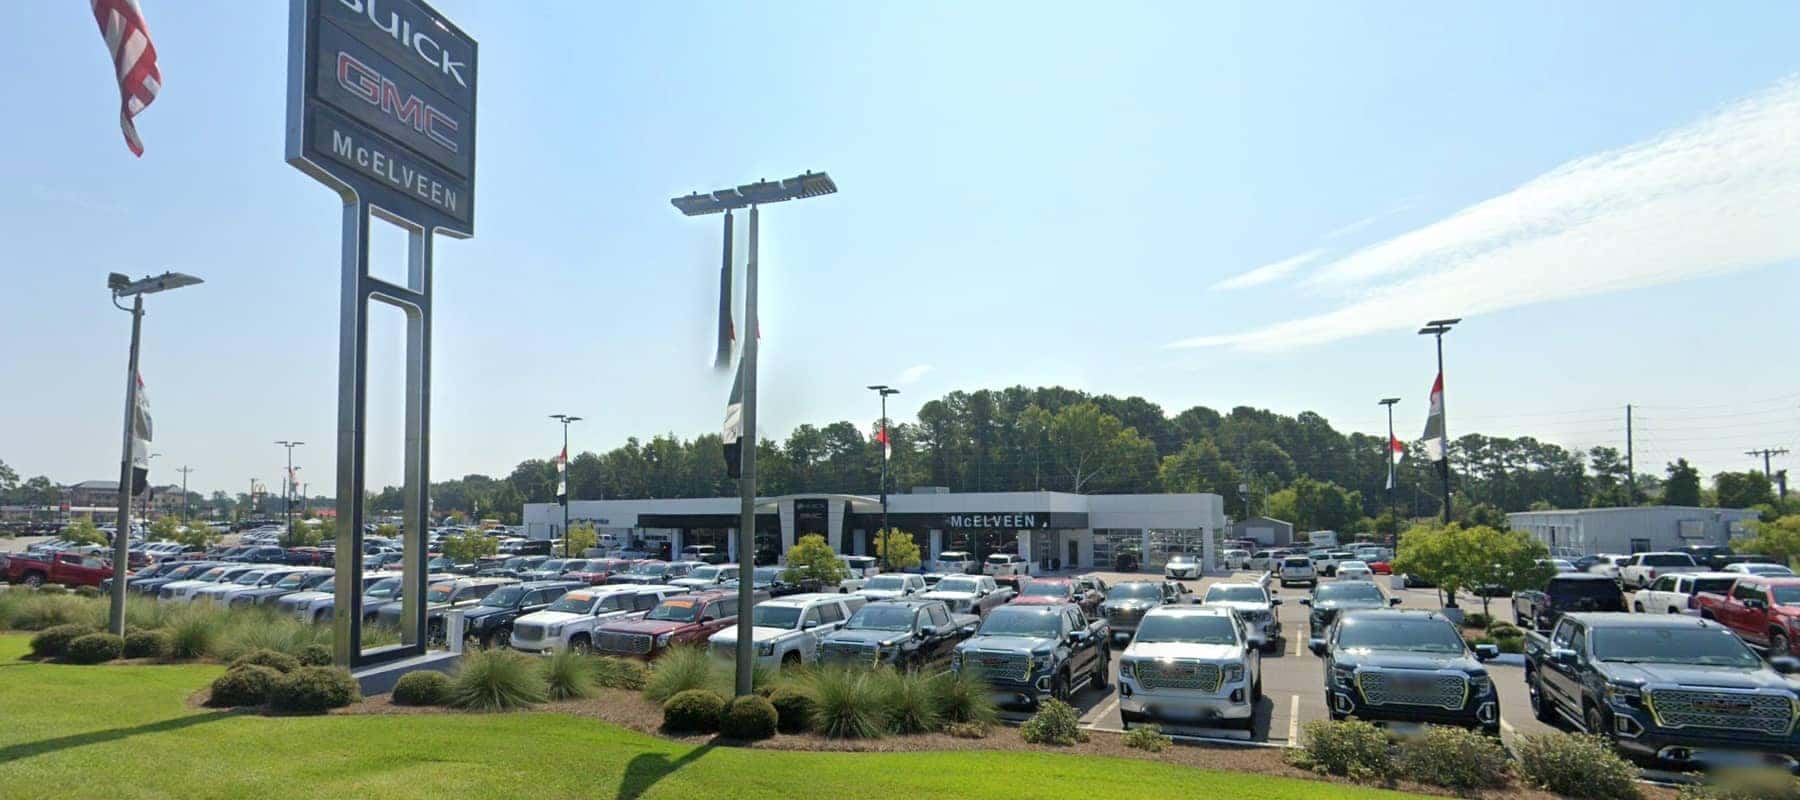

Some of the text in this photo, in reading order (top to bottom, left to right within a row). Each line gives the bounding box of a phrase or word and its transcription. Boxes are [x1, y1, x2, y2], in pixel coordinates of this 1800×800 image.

[337, 51, 458, 153] GMC
[333, 130, 456, 211] McELVEEN
[951, 515, 1035, 528] McELVEEN
